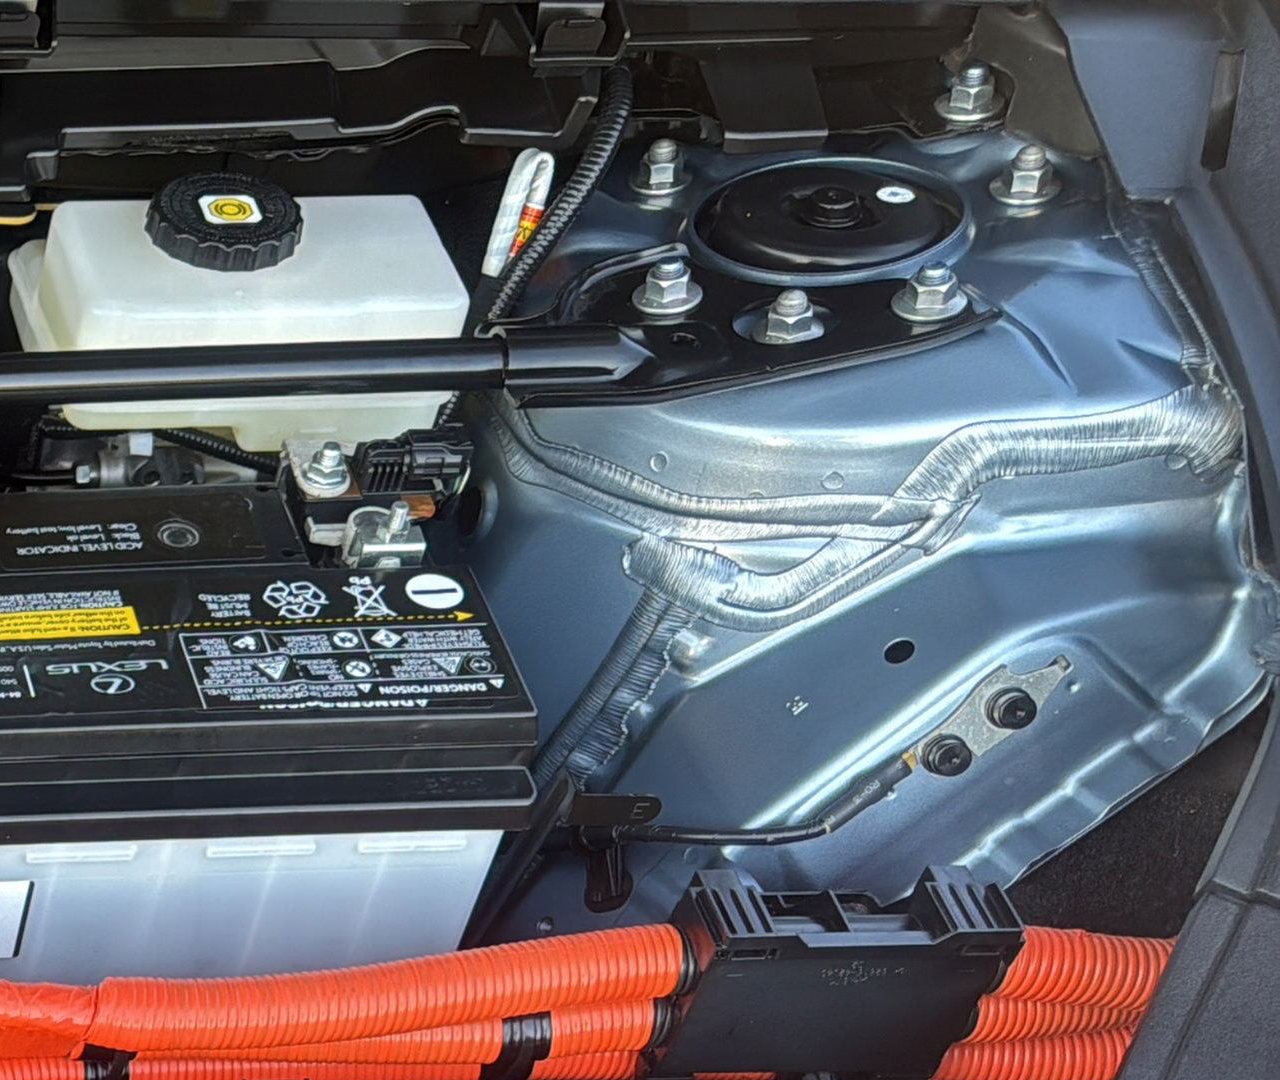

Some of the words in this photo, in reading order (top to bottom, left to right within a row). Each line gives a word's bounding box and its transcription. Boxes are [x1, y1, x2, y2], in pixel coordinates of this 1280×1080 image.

[77, 524, 102, 532] Level
[80, 533, 105, 542] Level
[16, 545, 79, 555] INDICATOR
[79, 542, 114, 551] LEVEL
[115, 542, 143, 550] ACID
[349, 576, 371, 585] Pb
[211, 609, 251, 617] BATTERY
[78, 641, 103, 649] Toyota
[114, 639, 156, 647] Distributed
[45, 659, 168, 675] LEXUS
[379, 682, 487, 694] DANGER/POISON
